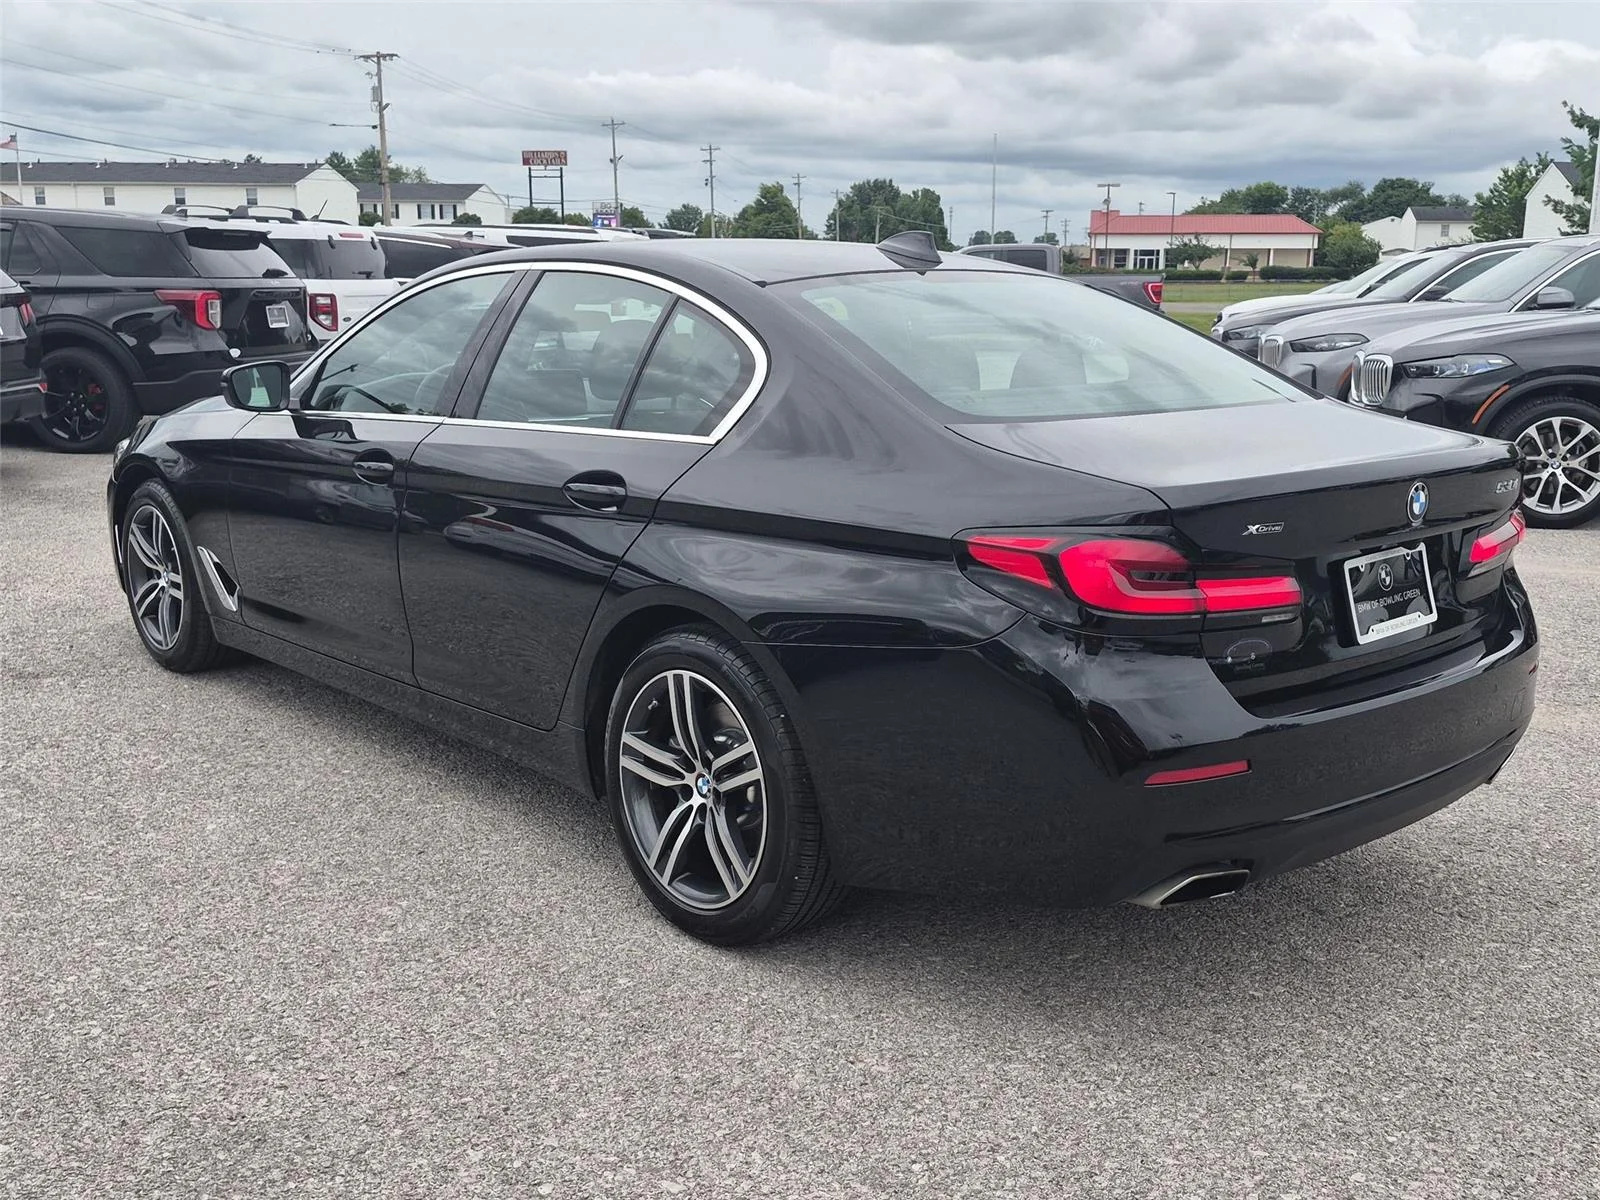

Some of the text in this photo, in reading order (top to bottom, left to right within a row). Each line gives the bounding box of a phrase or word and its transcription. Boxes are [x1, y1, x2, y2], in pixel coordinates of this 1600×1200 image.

[1358, 588, 1420, 613] BMW OF BOWLING GREEN
